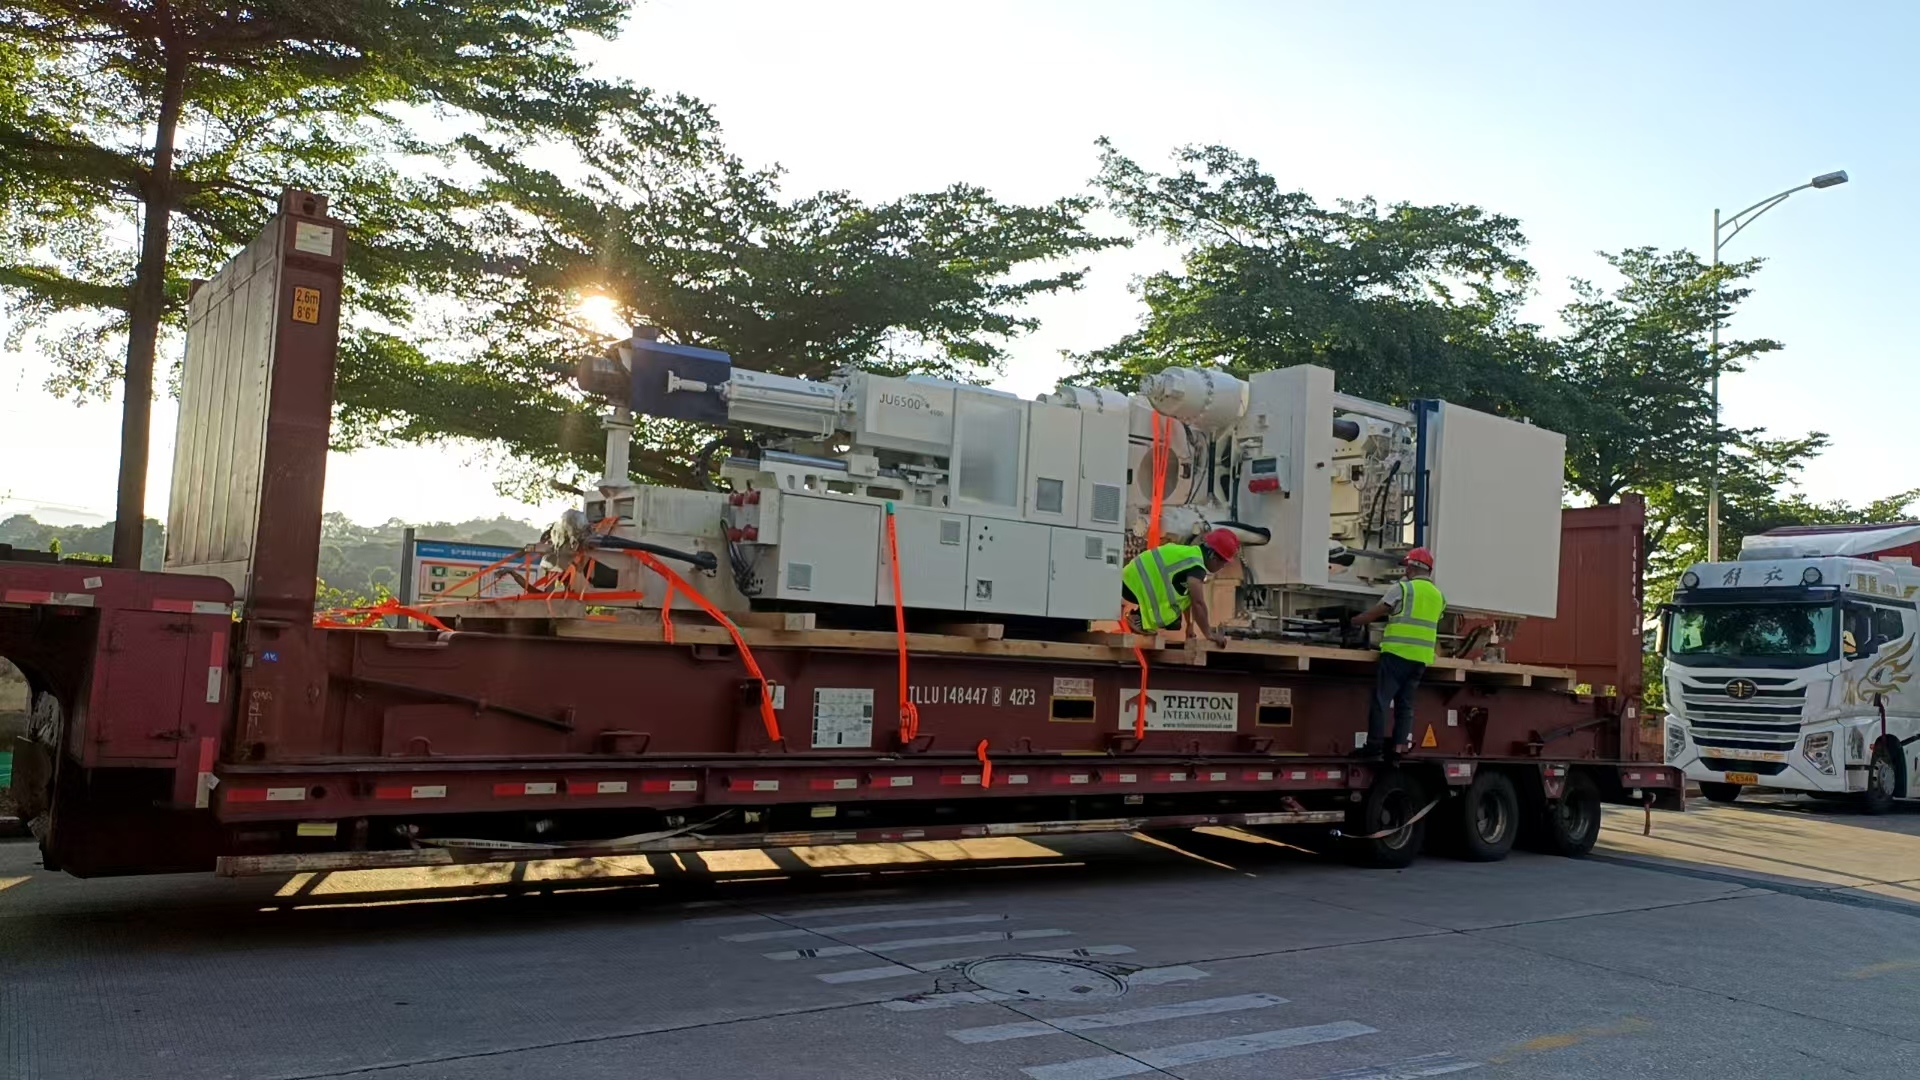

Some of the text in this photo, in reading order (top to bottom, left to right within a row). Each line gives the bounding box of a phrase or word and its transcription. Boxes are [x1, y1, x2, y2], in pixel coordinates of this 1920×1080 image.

[879, 393, 921, 410] JU6500
[909, 686, 1036, 705] TLLU 148447 8 42P3
[1163, 695, 1233, 710] TRITON
[1163, 710, 1233, 721] INTERNATIONAL
